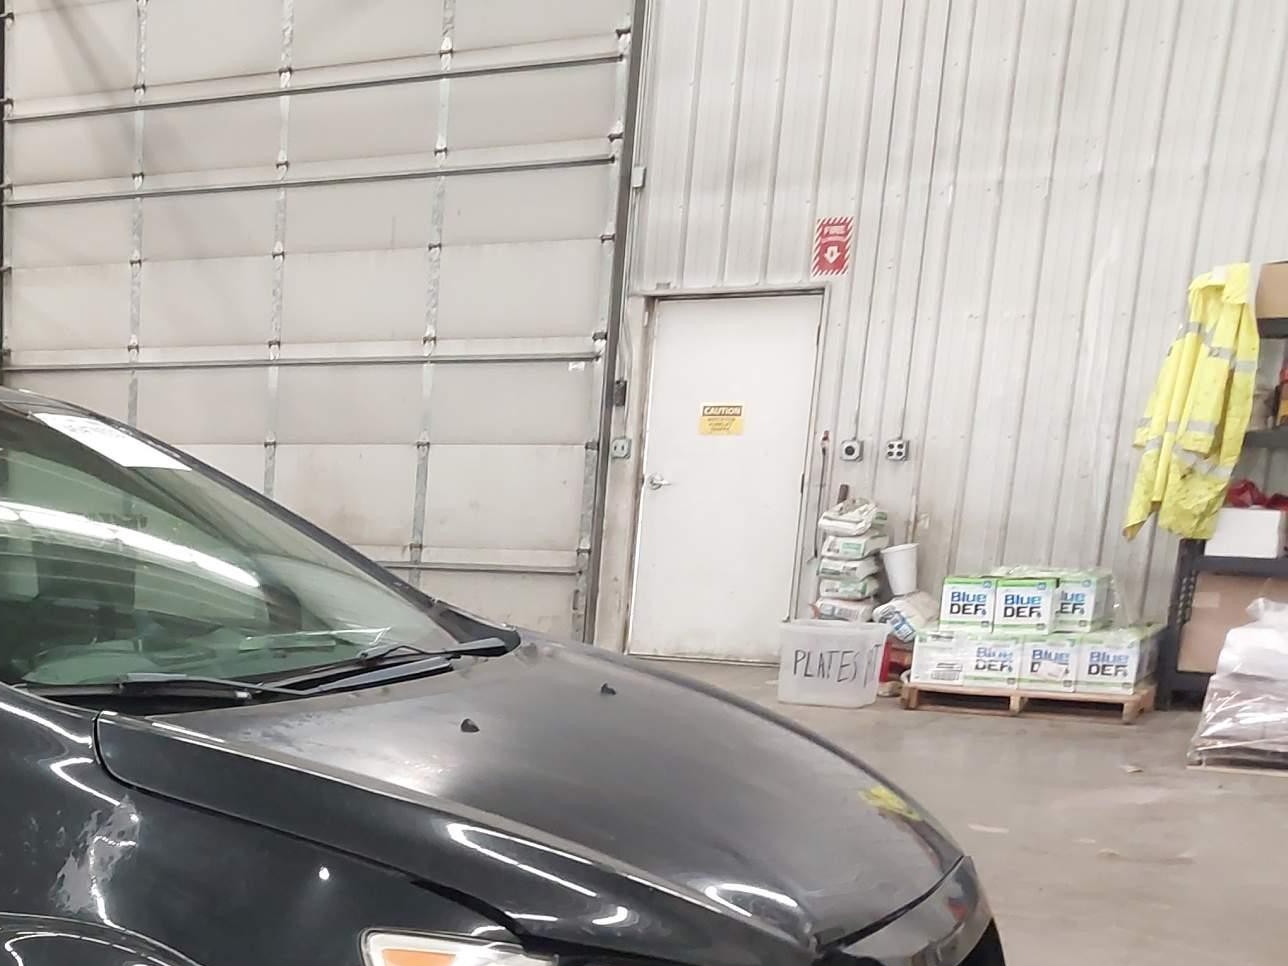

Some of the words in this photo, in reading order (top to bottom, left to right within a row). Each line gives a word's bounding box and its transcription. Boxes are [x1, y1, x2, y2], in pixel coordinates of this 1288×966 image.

[951, 591, 987, 602] Blue
[1004, 594, 1042, 605] Blue
[1060, 590, 1085, 602] lue
[949, 603, 986, 615] DEF
[1003, 606, 1041, 618] DEF
[1055, 602, 1085, 614] EF
[1032, 649, 1069, 663] Blue
[1089, 651, 1128, 664] Blue
[1087, 663, 1128, 677] DEF
